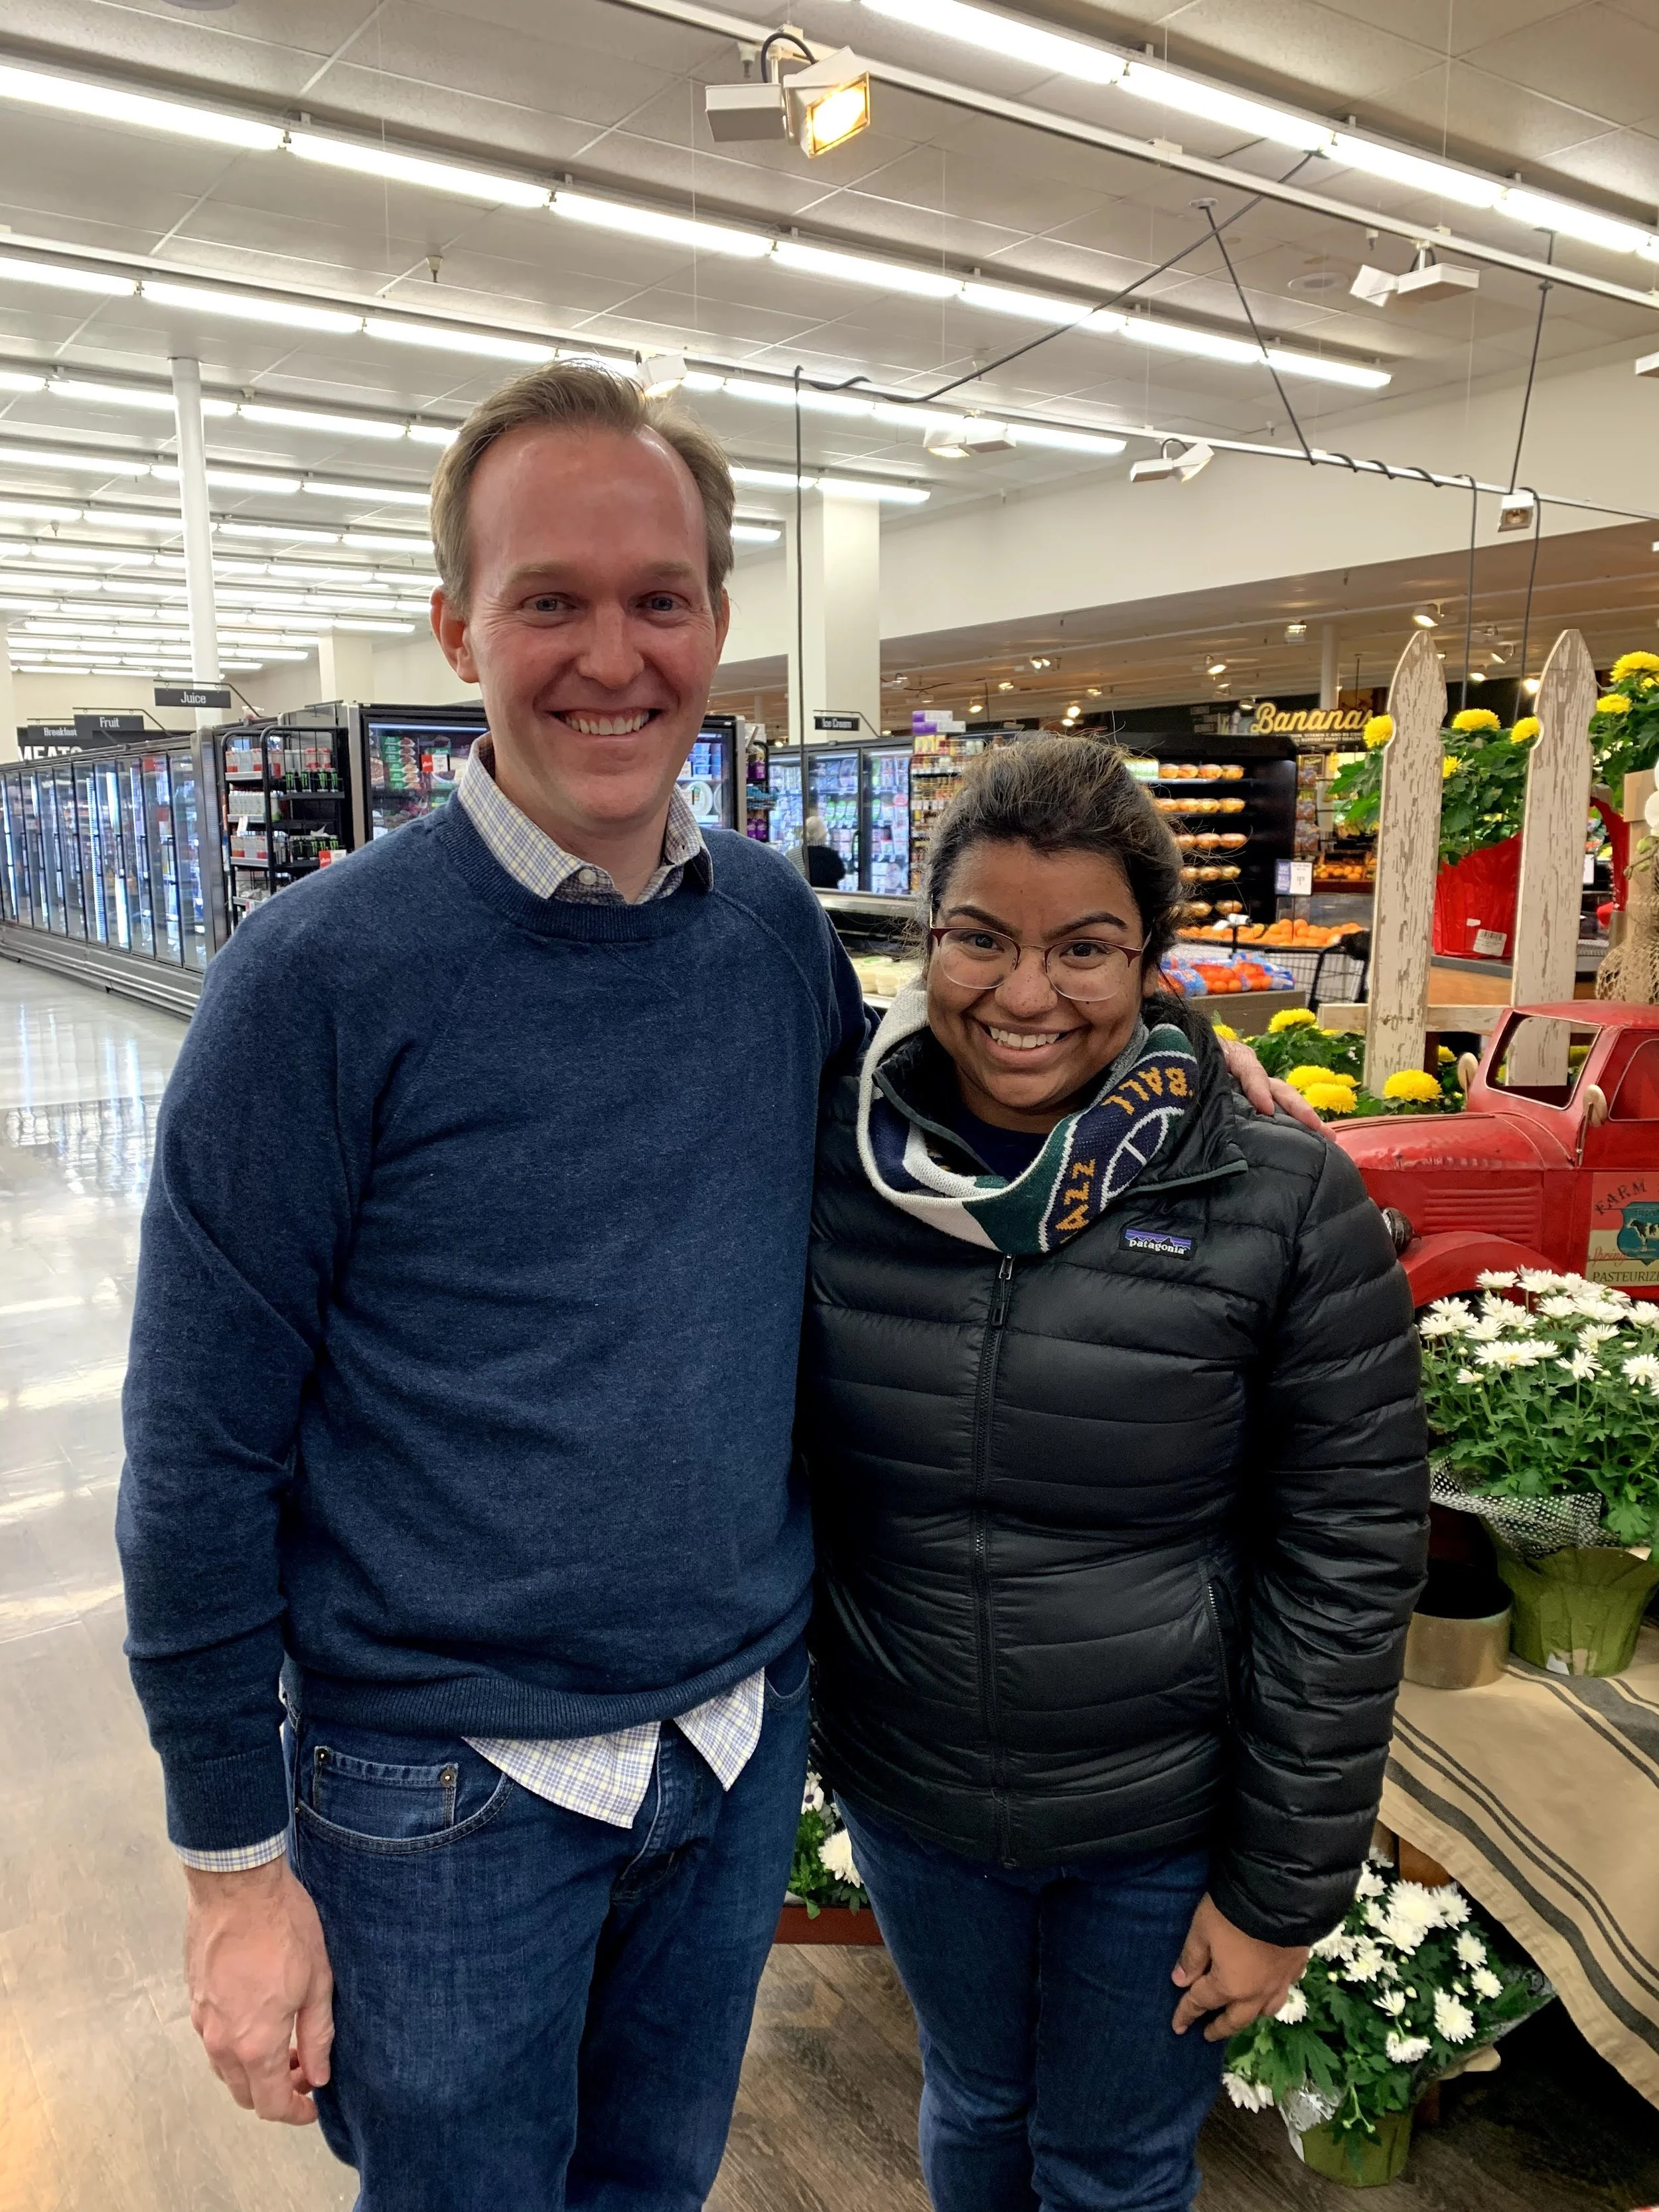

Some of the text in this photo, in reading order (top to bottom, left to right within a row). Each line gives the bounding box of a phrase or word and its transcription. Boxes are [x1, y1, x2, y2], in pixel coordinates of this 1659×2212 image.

[180, 692, 206, 703] Juice
[100, 717, 120, 728] Fruit
[832, 718, 852, 728] Cream
[44, 727, 78, 737] Breakfast
[1100, 1066, 1193, 1116] BALL
[1055, 1159, 1096, 1244] AZZ
[1595, 1178, 1647, 1215] FARM
[1129, 1239, 1185, 1255] patagonia
